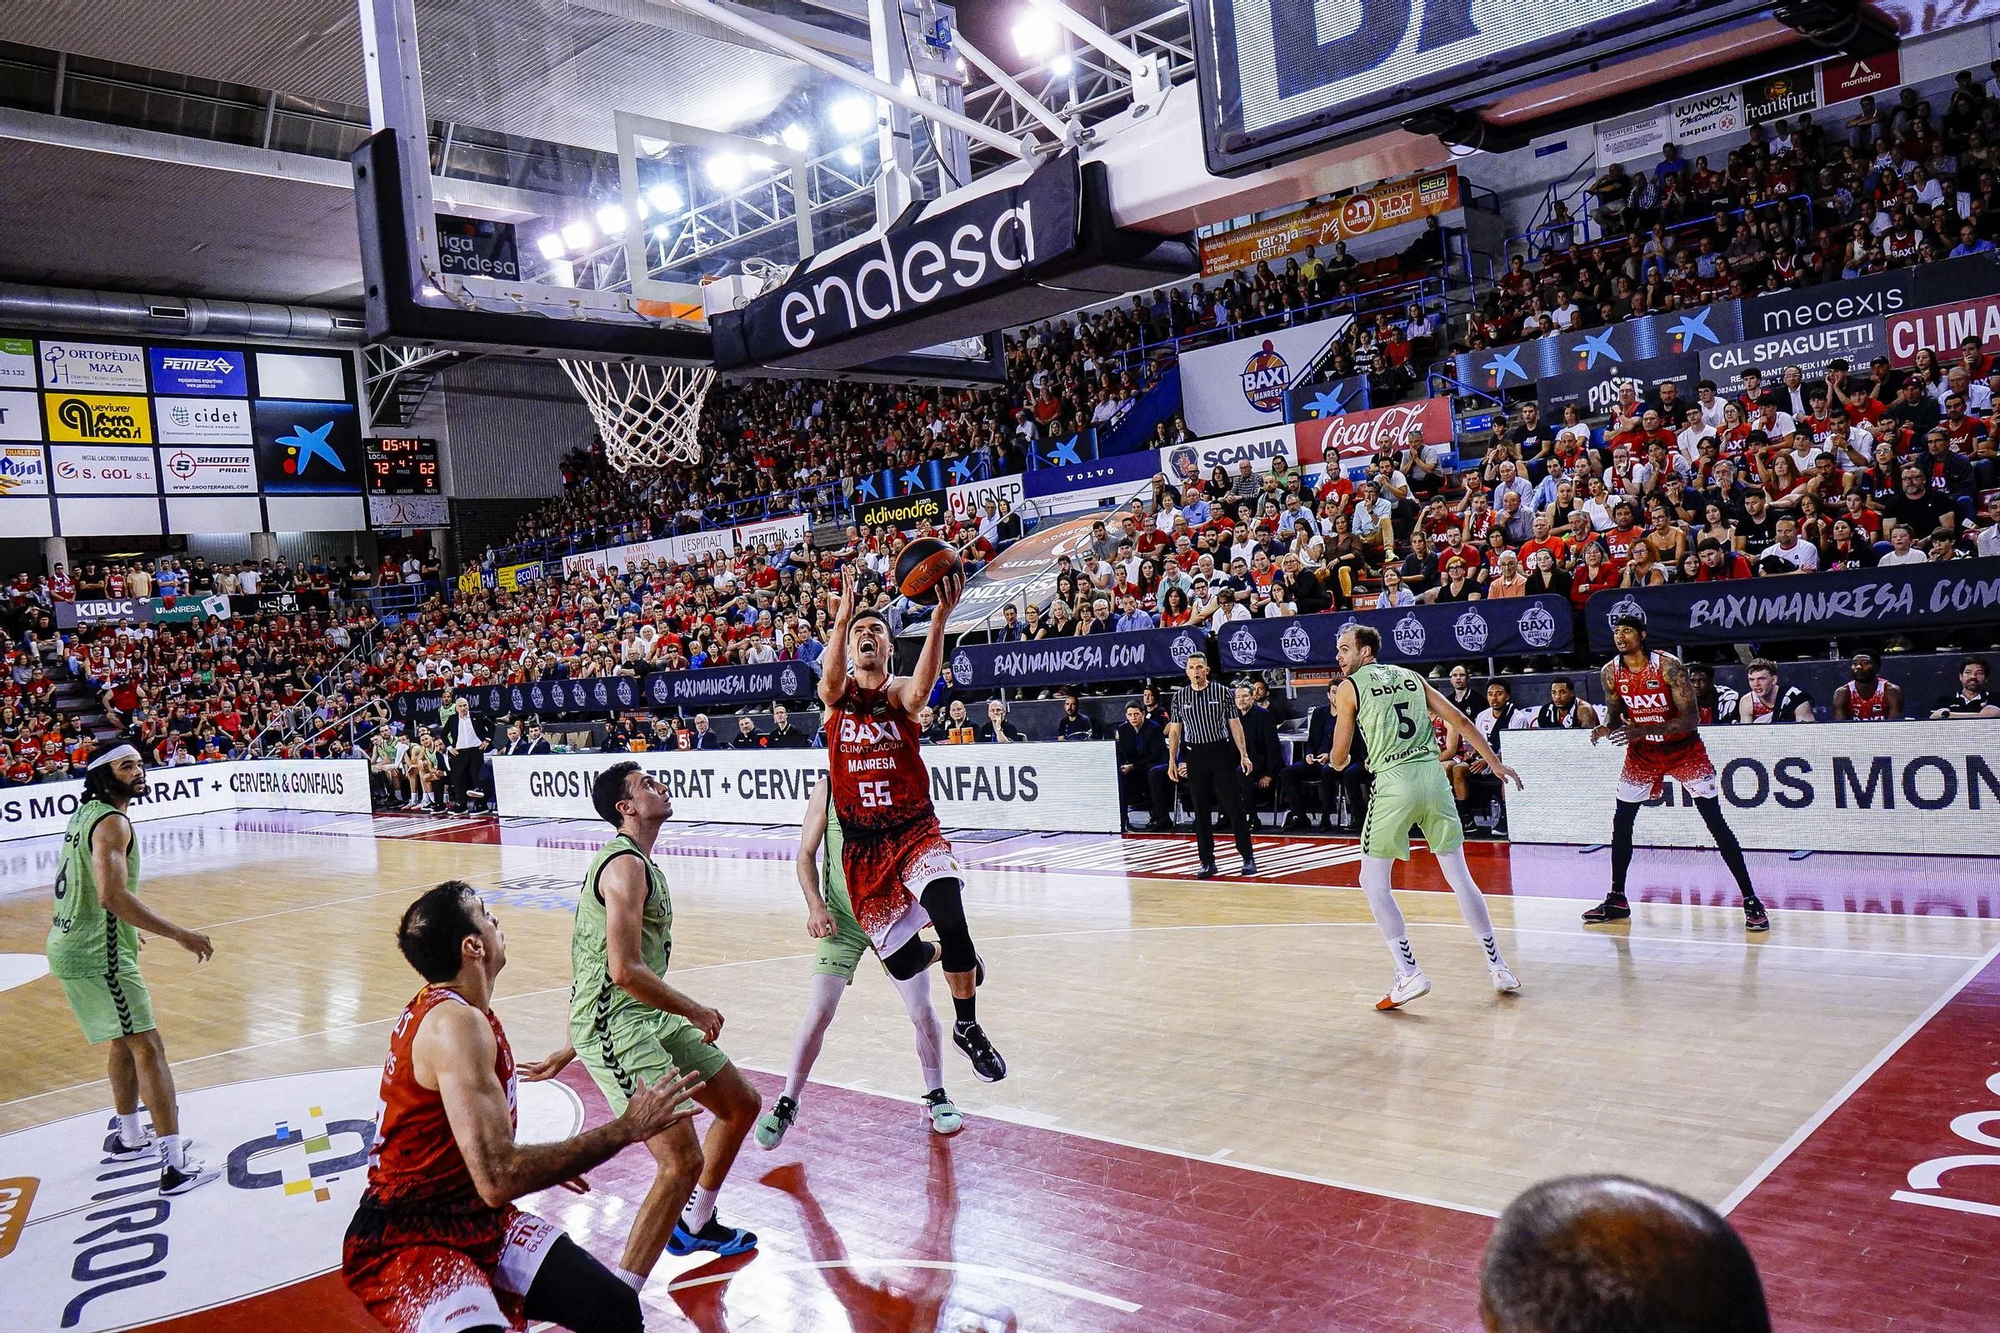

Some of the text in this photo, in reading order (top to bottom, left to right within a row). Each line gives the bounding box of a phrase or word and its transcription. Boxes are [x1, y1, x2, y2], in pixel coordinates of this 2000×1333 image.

[1842, 73, 1881, 88] montepio
[1675, 92, 1738, 118] JUANOLA
[1744, 89, 1818, 120] frankfurt
[1680, 122, 1717, 138] expert
[1421, 177, 1446, 192] SER
[1437, 189, 1449, 198] FM
[1379, 192, 1413, 213] TDT
[1347, 214, 1372, 227] taronja
[438, 230, 464, 253] liga
[1250, 243, 1291, 262] DIGITAL
[441, 253, 517, 276] endesa
[780, 199, 1035, 348] endesa
[1763, 287, 1904, 332] mecexis
[1892, 303, 2000, 359] CLIMA
[69, 348, 141, 363] ORTOPÈDIA
[1708, 322, 1875, 371] CAL SPAGUETTI
[89, 363, 124, 374] MAZA
[1241, 366, 1290, 391] BAXI
[1716, 385, 1737, 395] 08243
[194, 407, 238, 423] cidet
[1321, 402, 1429, 454] Coca-Cola
[5, 448, 41, 457] QUALITAT
[382, 439, 419, 451] 05:41
[1203, 438, 1290, 469] SCANIA
[0, 457, 43, 478] Pujol
[197, 456, 250, 464] SHOOTER
[373, 462, 390, 475] 72
[419, 462, 436, 475] 62
[82, 468, 153, 480] S. GOL S.L.
[1066, 467, 1115, 482] VOLVO
[917, 497, 931, 506] .com
[864, 500, 940, 527] eldivendres
[565, 555, 596, 574] Kadira
[909, 557, 952, 593] SPALDING
[76, 601, 134, 618] KIBUC
[1689, 577, 2000, 629] BAXIMANRESA.COM
[1456, 623, 1488, 637] BAXI
[1519, 618, 1554, 632] BAXI
[1282, 634, 1310, 649] BAXI
[1395, 628, 1426, 642] BAXI
[1171, 645, 1198, 656] BAXI
[1230, 640, 1256, 652] BAXI
[953, 663, 973, 674] BAXI
[994, 643, 1146, 677] BAXIMANRESA.COM
[673, 674, 774, 698] BAXIMANRESA.COM
[780, 677, 798, 686] BAXI
[1622, 692, 1668, 710] BAXI
[1393, 701, 1417, 740] 5
[840, 718, 902, 745] BAXI
[848, 756, 897, 773] MANRESA
[230, 771, 281, 794] CERVERA
[281, 775, 290, 793] &
[291, 771, 345, 796] GONFAUS
[529, 770, 580, 798] GROS
[858, 780, 894, 808] 55
[55, 858, 69, 900] 6
[515, 1221, 539, 1248] ETL
